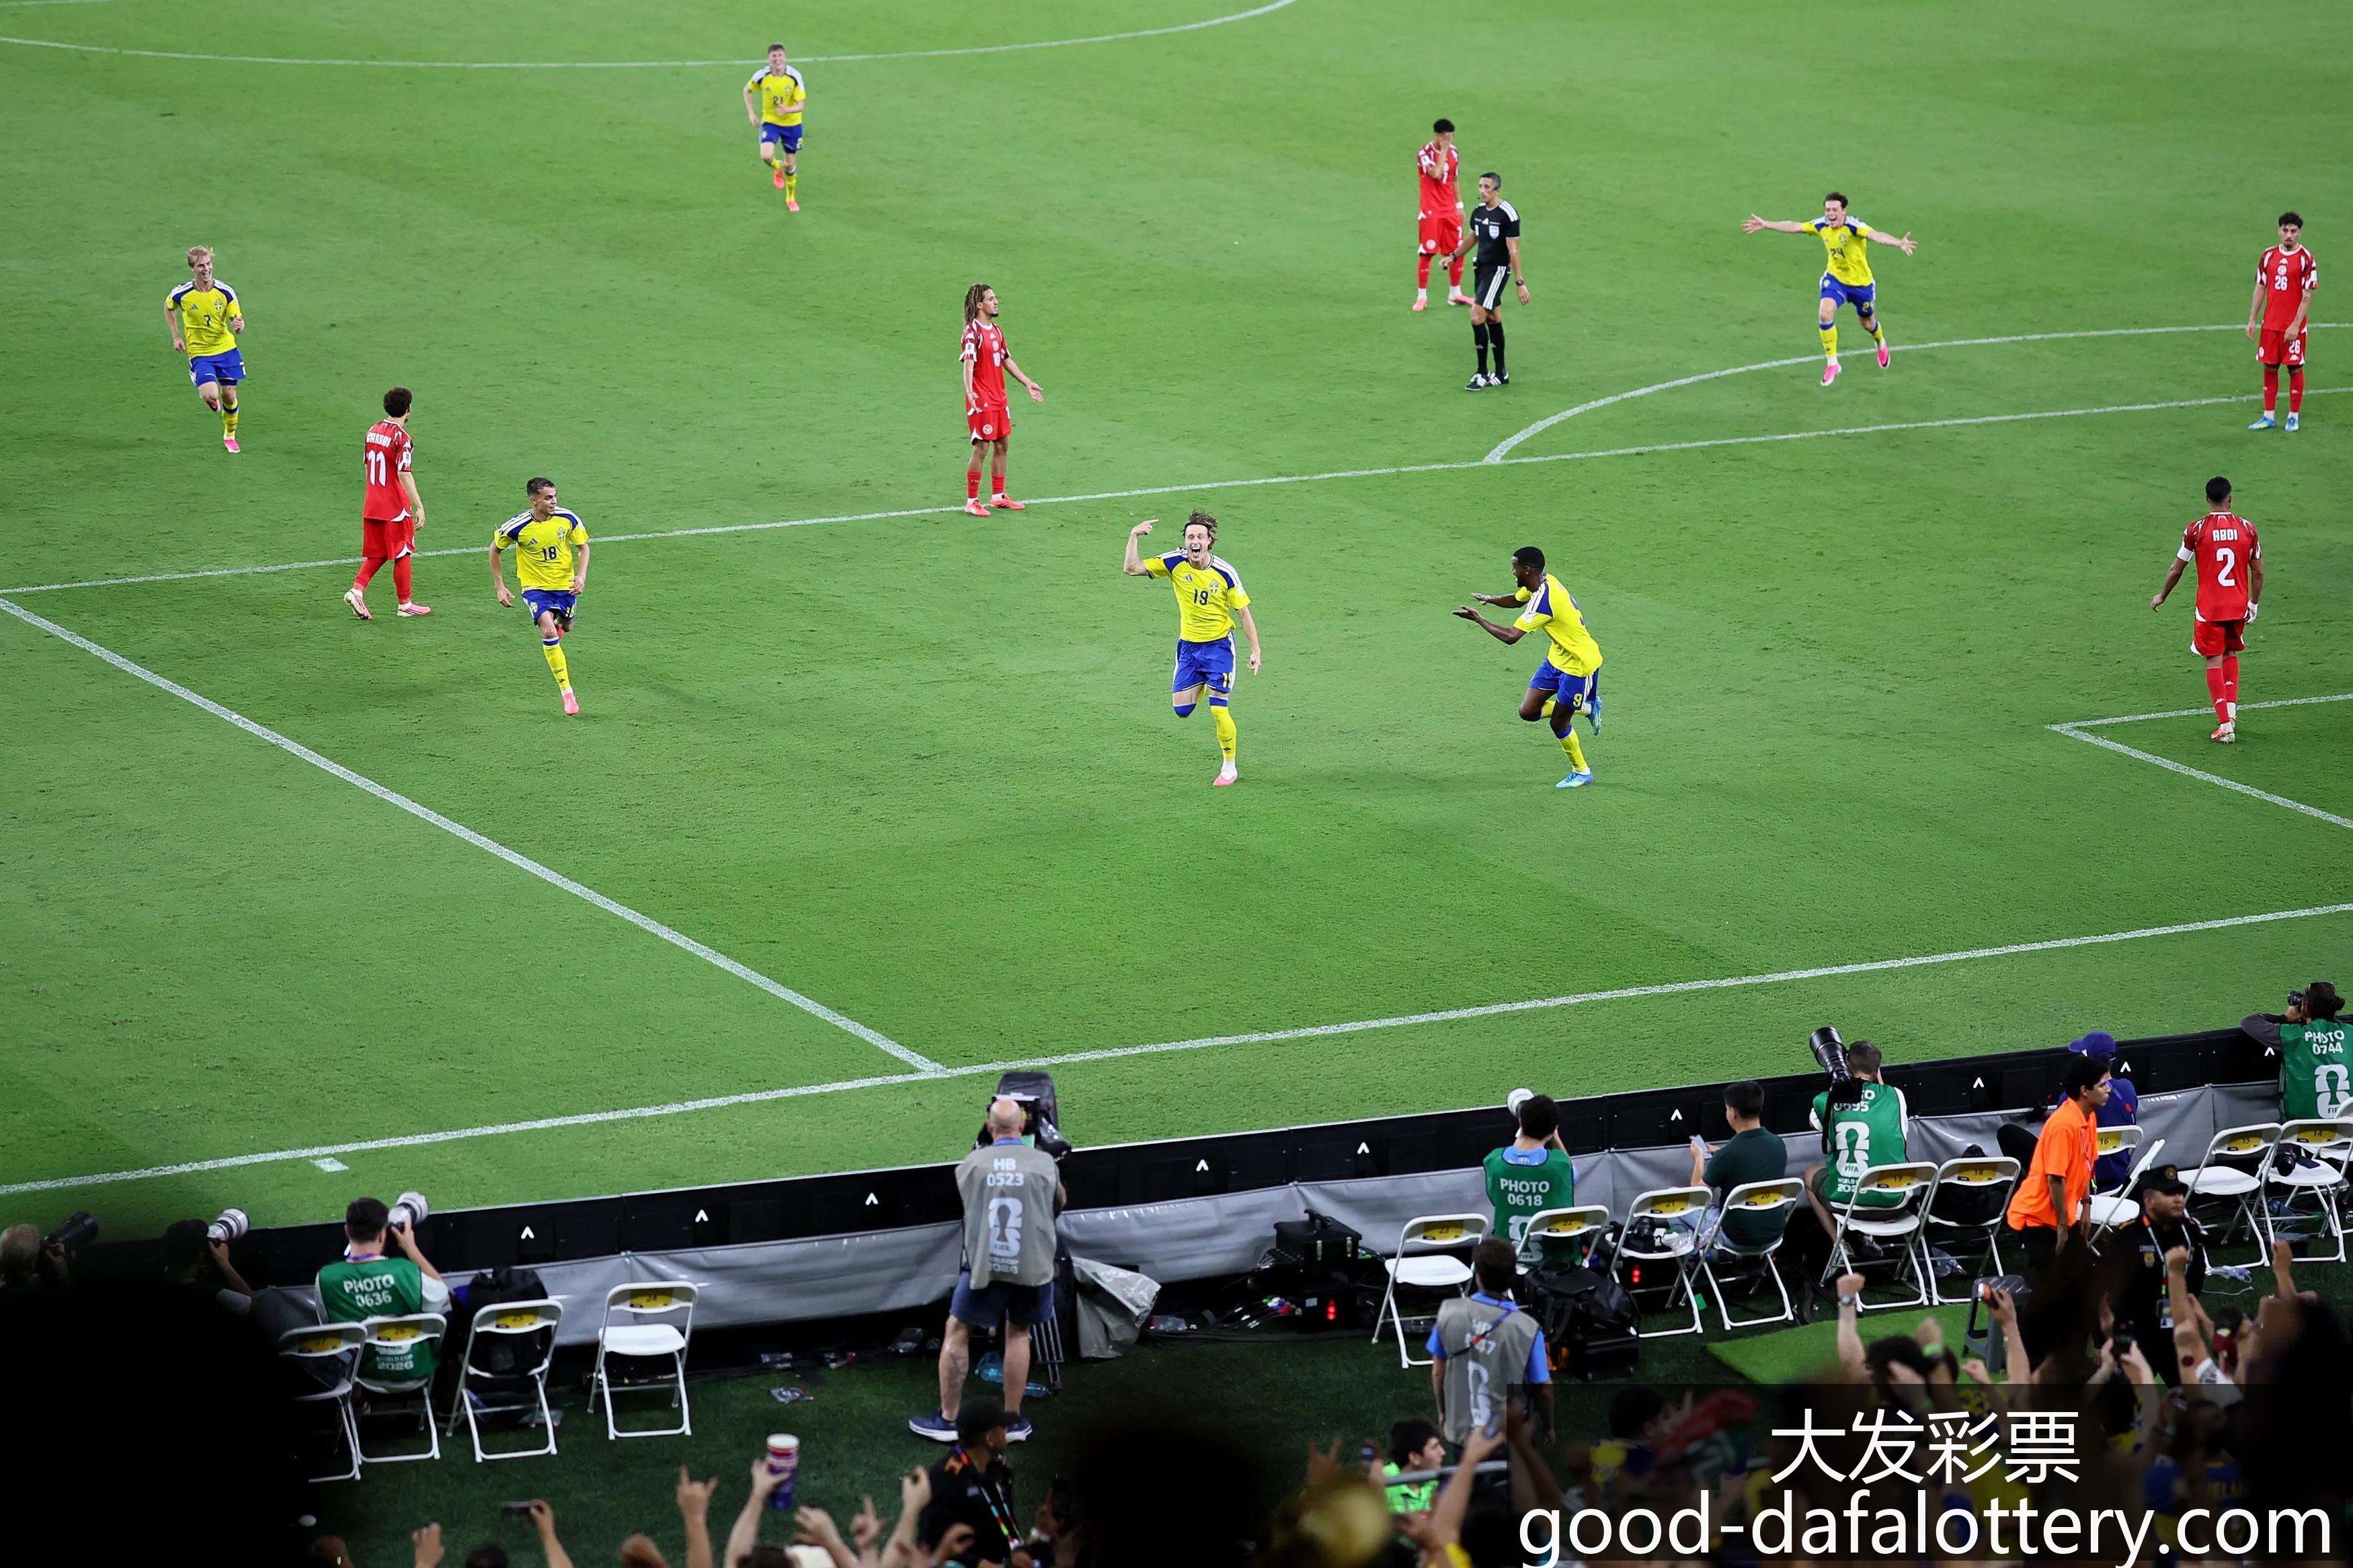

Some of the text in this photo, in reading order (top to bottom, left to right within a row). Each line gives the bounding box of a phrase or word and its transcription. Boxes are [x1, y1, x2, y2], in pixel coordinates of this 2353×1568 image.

[1831, 248, 1845, 260] 24
[2274, 274, 2288, 290] 26
[204, 314, 211, 327] 7
[992, 352, 1001, 367] 10
[366, 449, 387, 487] 11
[2212, 528, 2238, 542] ABDI
[542, 546, 557, 562] 18
[2216, 548, 2235, 587] 2
[1193, 589, 1209, 606] 19
[1572, 693, 1583, 707] 9
[2312, 1042, 2344, 1055] 0744
[993, 1157, 1016, 1171] HB
[986, 1172, 1025, 1187] 0523
[1500, 1178, 1550, 1193] PHOTO
[1507, 1193, 1544, 1207] 0618
[343, 1274, 395, 1294] PHOTO
[356, 1290, 393, 1307] 0636
